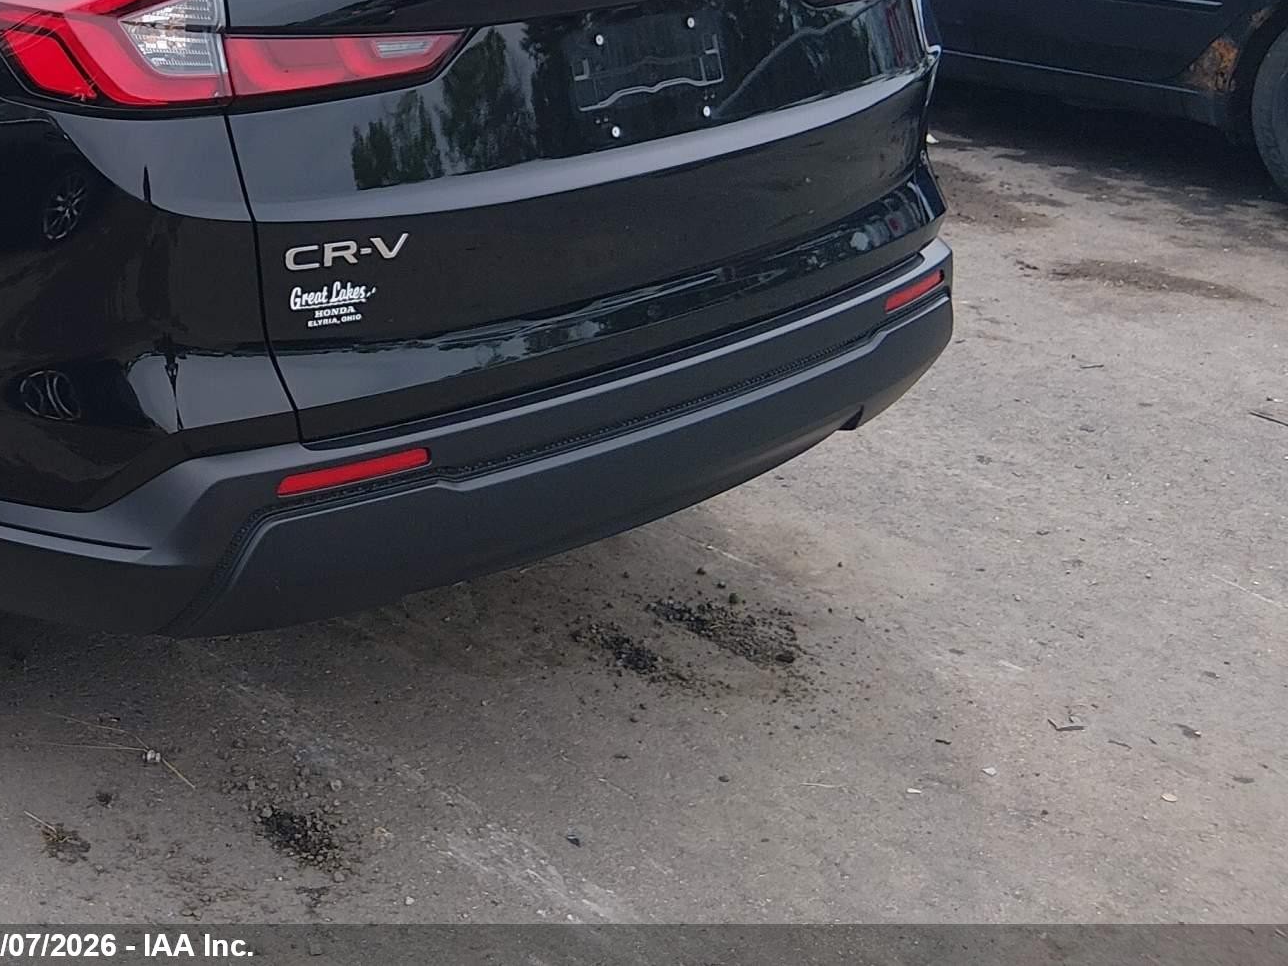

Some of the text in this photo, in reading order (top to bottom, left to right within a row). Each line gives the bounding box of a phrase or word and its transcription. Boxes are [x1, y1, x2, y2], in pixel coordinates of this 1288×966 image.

[285, 232, 409, 271] CR-V
[290, 280, 367, 310] Great Lakes
[314, 305, 356, 318] HONDA
[340, 313, 363, 323] OHIO
